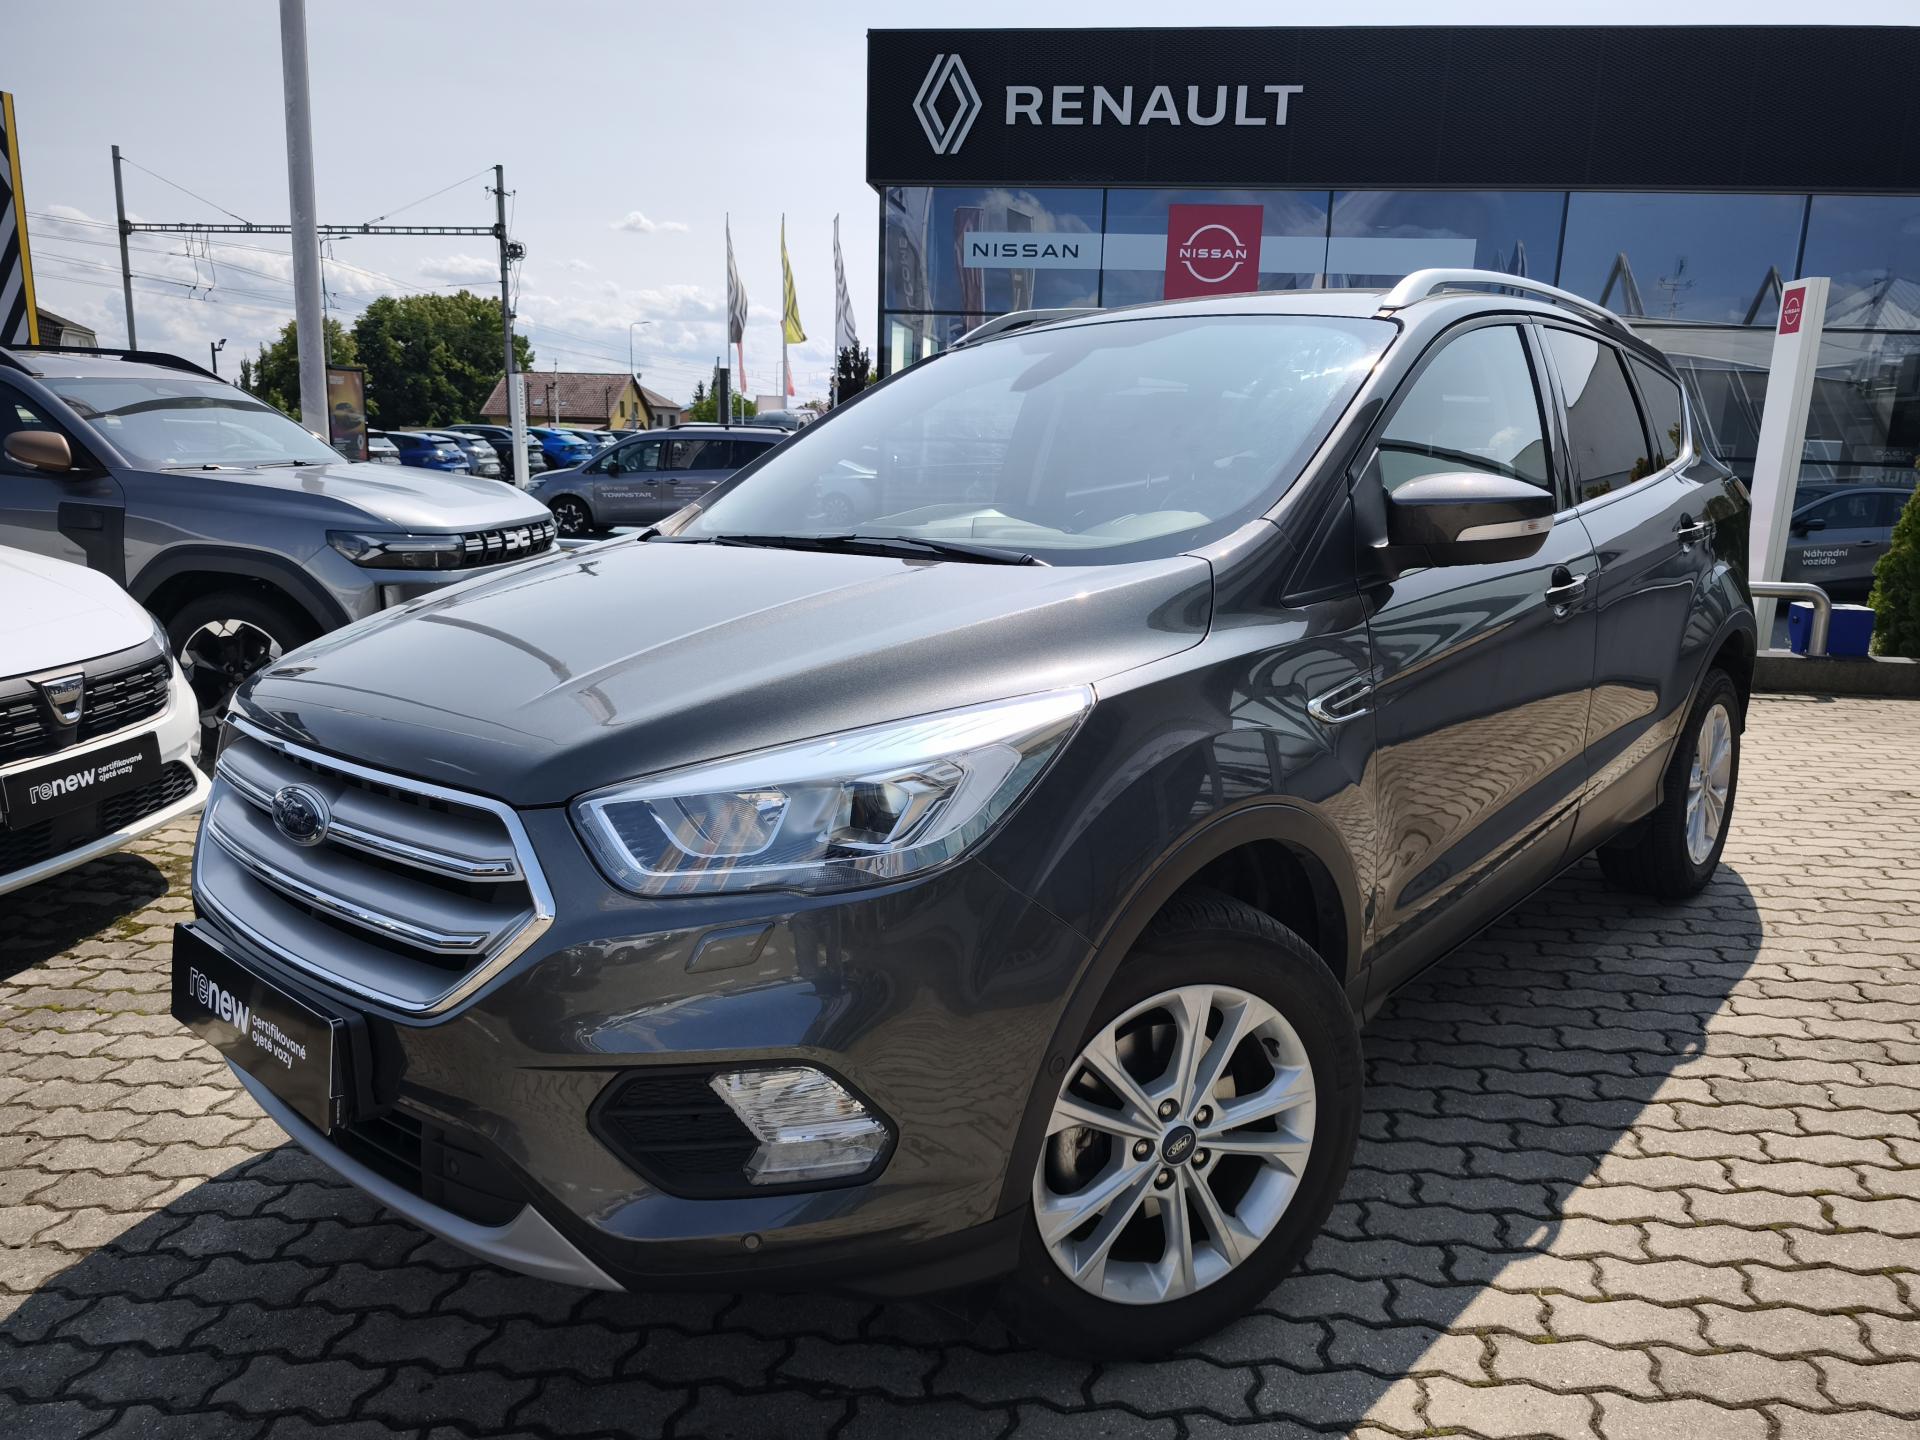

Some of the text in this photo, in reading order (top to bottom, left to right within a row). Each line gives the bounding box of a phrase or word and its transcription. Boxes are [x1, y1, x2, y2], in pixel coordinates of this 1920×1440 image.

[1005, 85, 1304, 126] RENAULT
[973, 243, 1079, 258] NISSAN
[1180, 248, 1246, 259] NISSAN
[1802, 558, 1836, 566] vozidlo
[1803, 548, 1848, 557] Náhradní
[98, 753, 143, 774] certifikované
[99, 765, 133, 782] ojeté vozy
[29, 768, 95, 805] renew
[189, 966, 250, 1035] renew
[252, 1014, 307, 1060] certifikované
[252, 1030, 293, 1069] ojeté vozy
[1170, 1136, 1189, 1156] Ford
